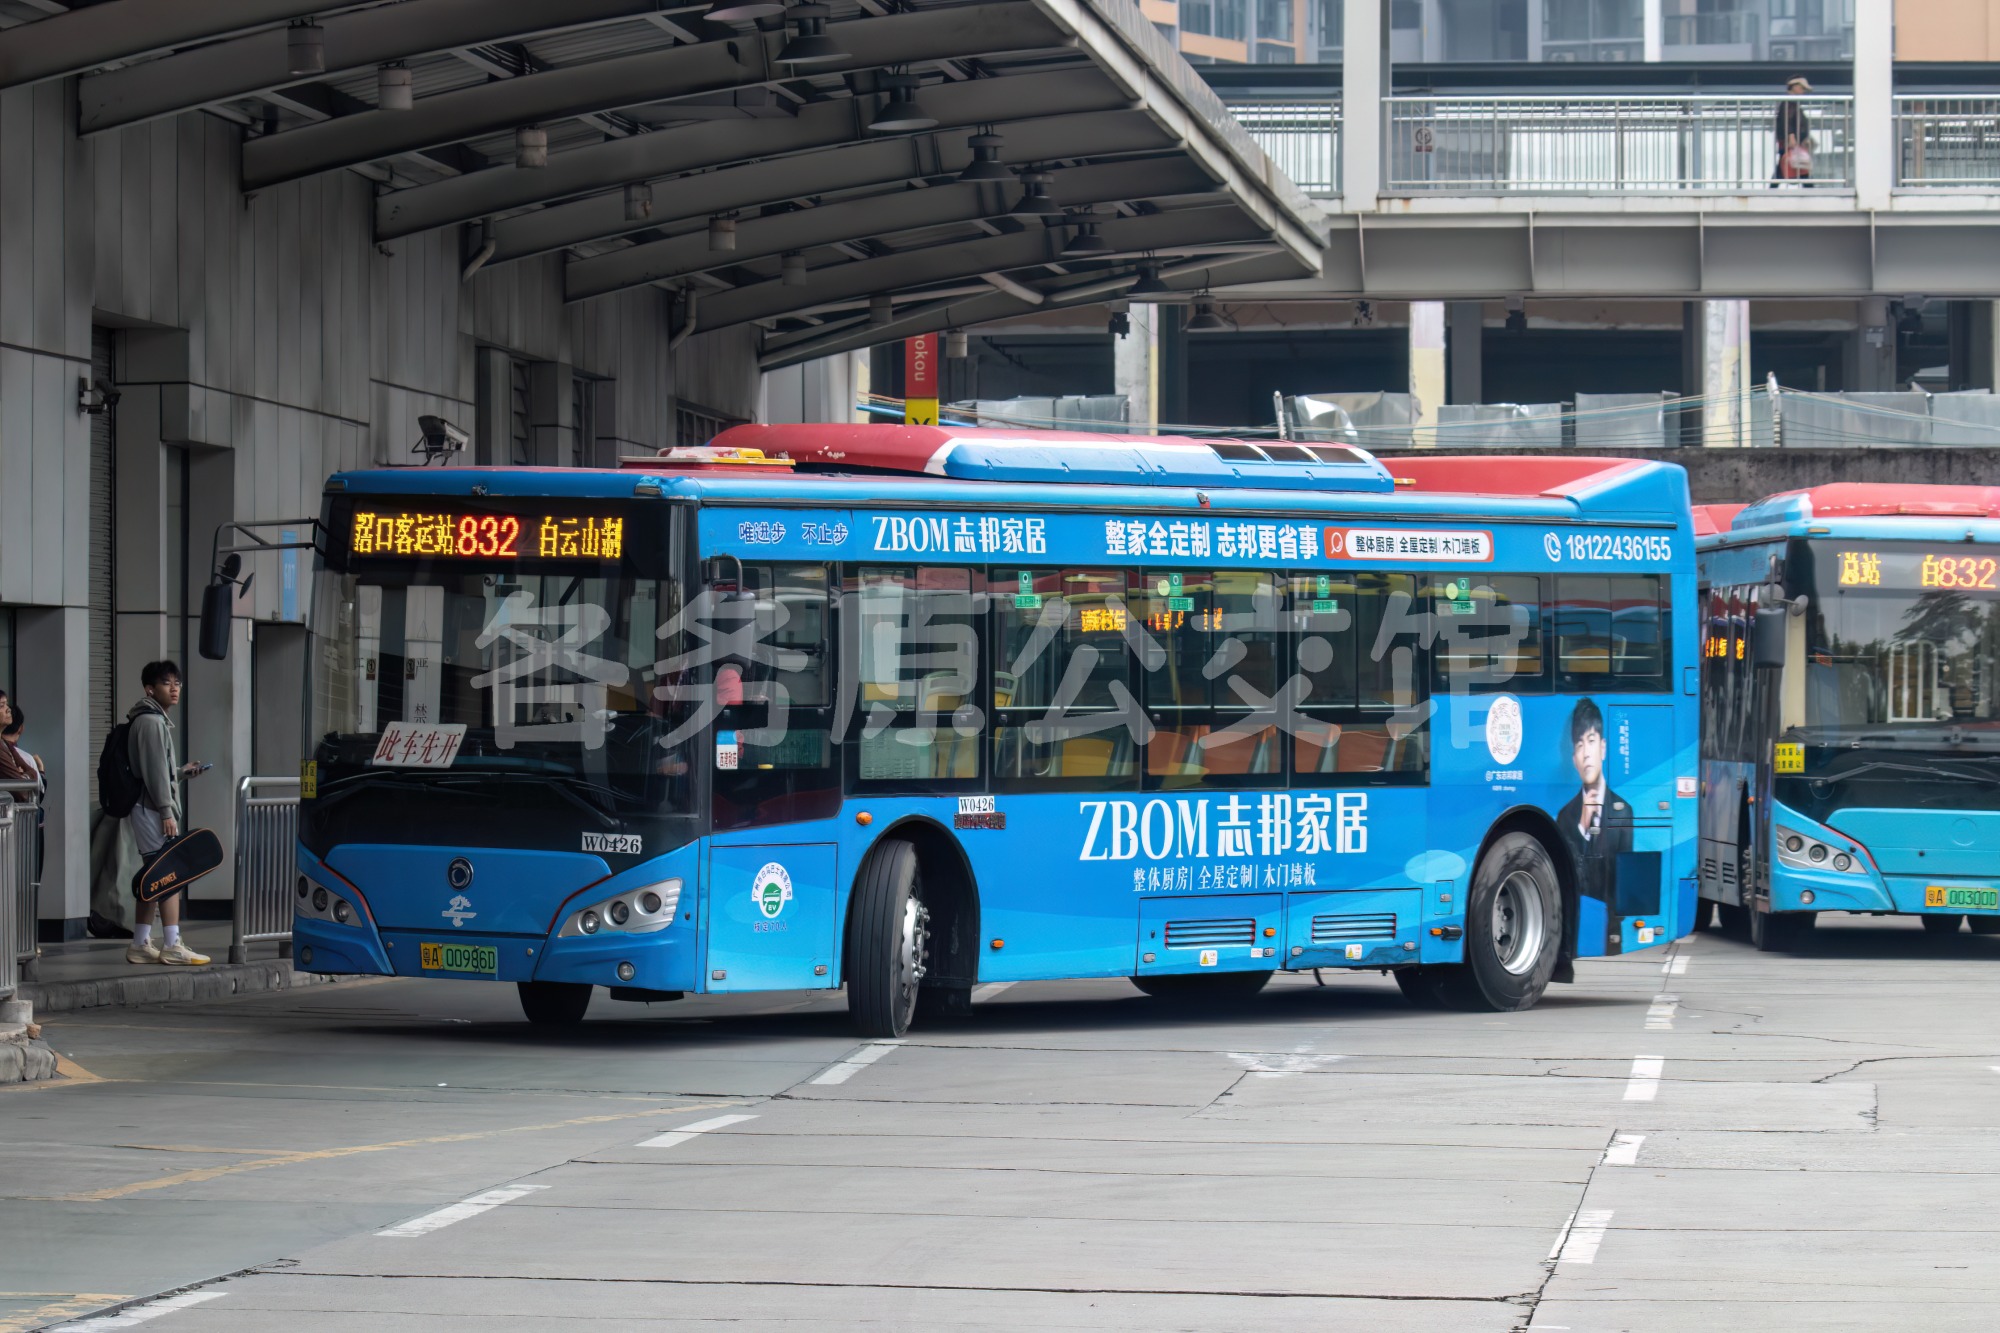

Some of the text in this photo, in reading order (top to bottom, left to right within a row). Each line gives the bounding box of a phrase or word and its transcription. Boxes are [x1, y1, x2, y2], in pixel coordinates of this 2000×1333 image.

[458, 515, 519, 556] 832
[738, 521, 849, 545] 唯进步 不止步
[872, 516, 1047, 553] ZBOM 志邦家居
[1105, 520, 1319, 560] 整家全定制 志邦更省事
[1355, 535, 1481, 554] 整体厨房 全屋定制 木门墙板
[1565, 534, 1672, 562] 18122436155
[1939, 557, 1997, 588] 832
[375, 730, 461, 764] 此车先开
[959, 798, 994, 812] W0426
[1079, 792, 1368, 861] ZBOM 志邦家居
[583, 835, 640, 854] W0426
[1133, 862, 1317, 892] 整体厨房 全屋定制 木门墙板
